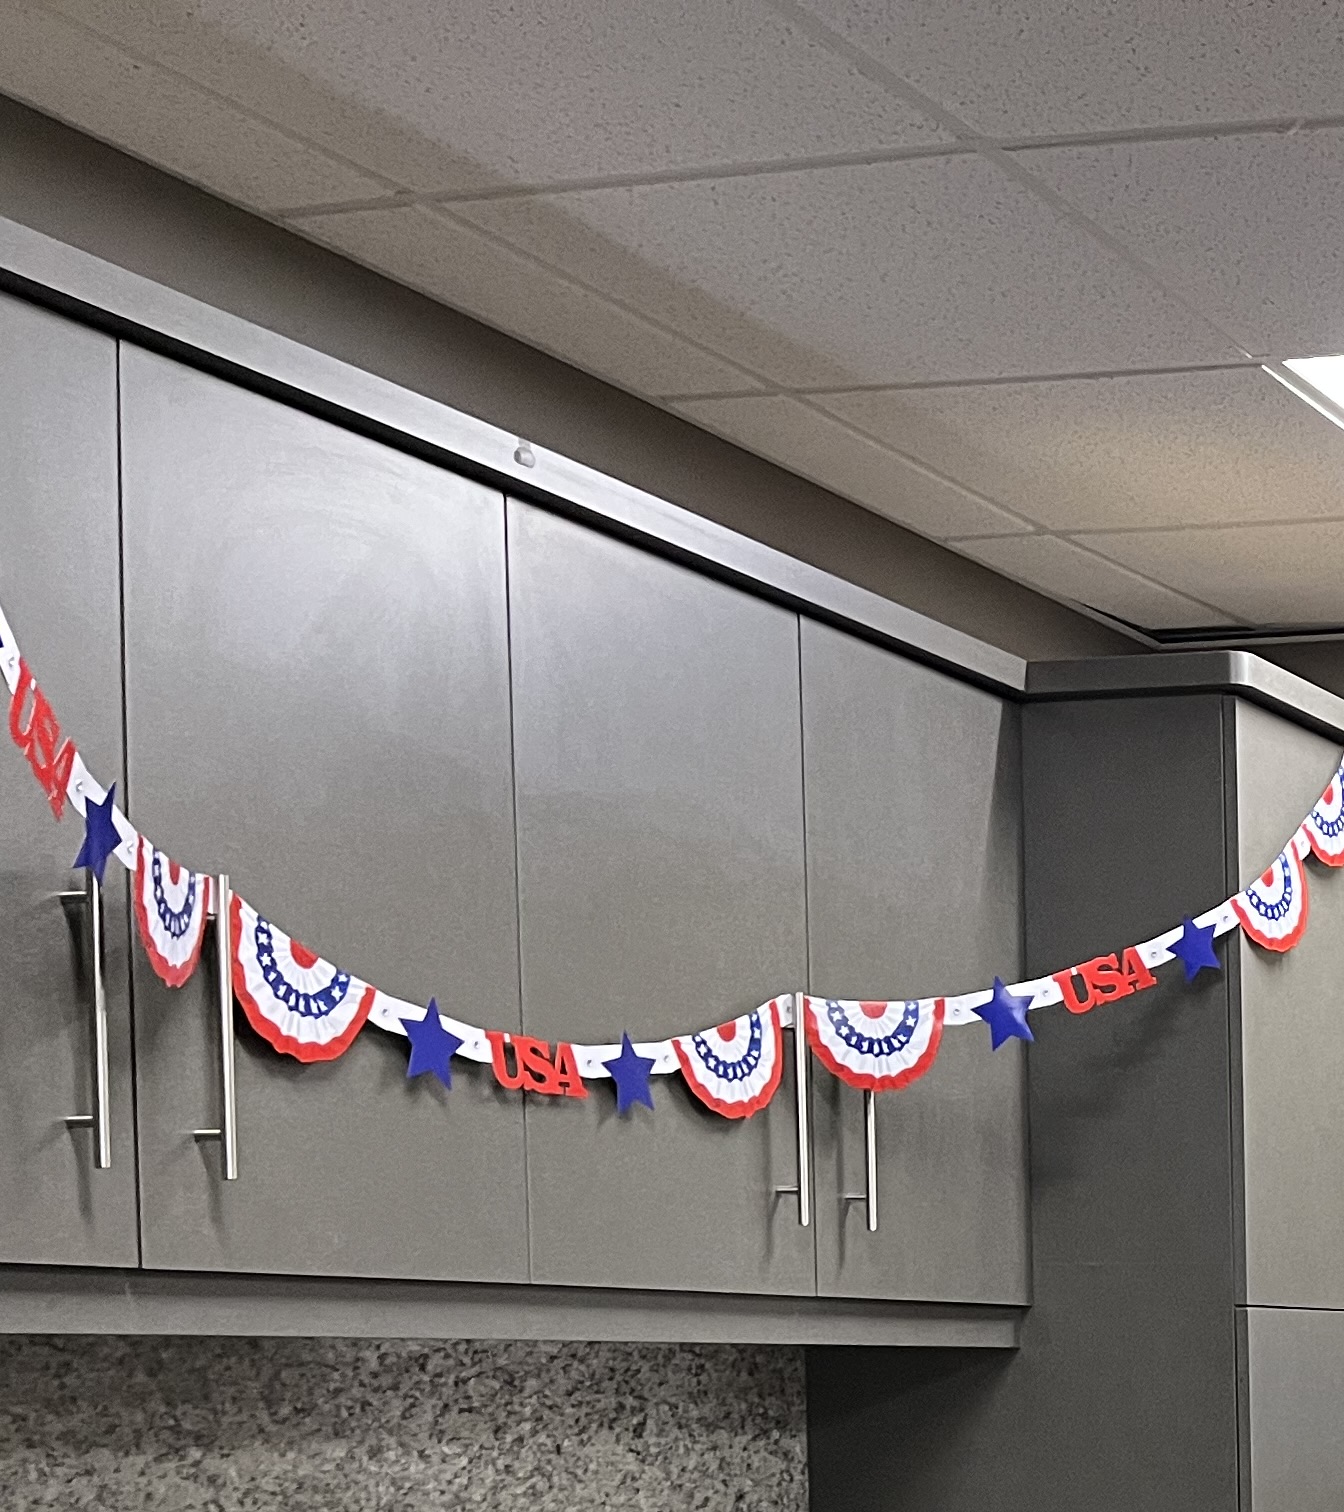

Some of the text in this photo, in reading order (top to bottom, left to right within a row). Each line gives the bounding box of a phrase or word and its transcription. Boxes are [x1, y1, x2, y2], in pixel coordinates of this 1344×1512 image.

[9, 656, 77, 822] USA
[1053, 947, 1157, 1014] USA
[487, 1031, 588, 1098] USA
